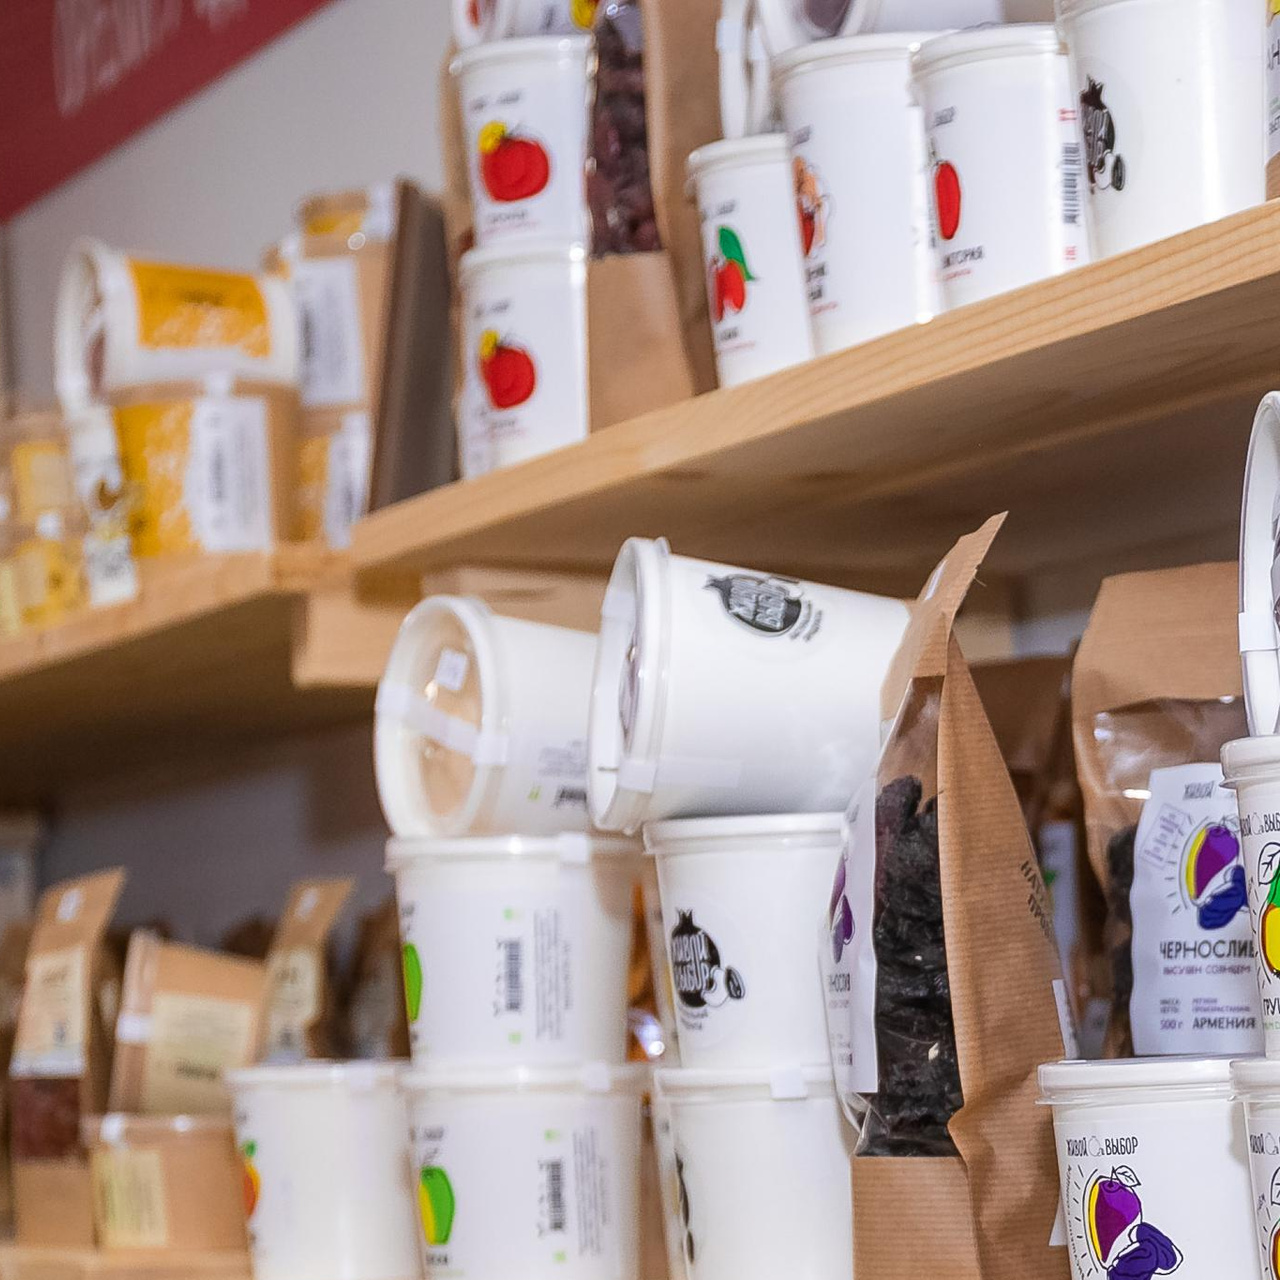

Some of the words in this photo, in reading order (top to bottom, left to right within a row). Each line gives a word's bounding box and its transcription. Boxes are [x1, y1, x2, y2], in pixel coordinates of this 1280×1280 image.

[1192, 1017, 1256, 1030] АРМЕНИЯ
[1066, 1137, 1089, 1158] ЖИВОЙ
[1105, 1136, 1138, 1156] ВЫБОР
